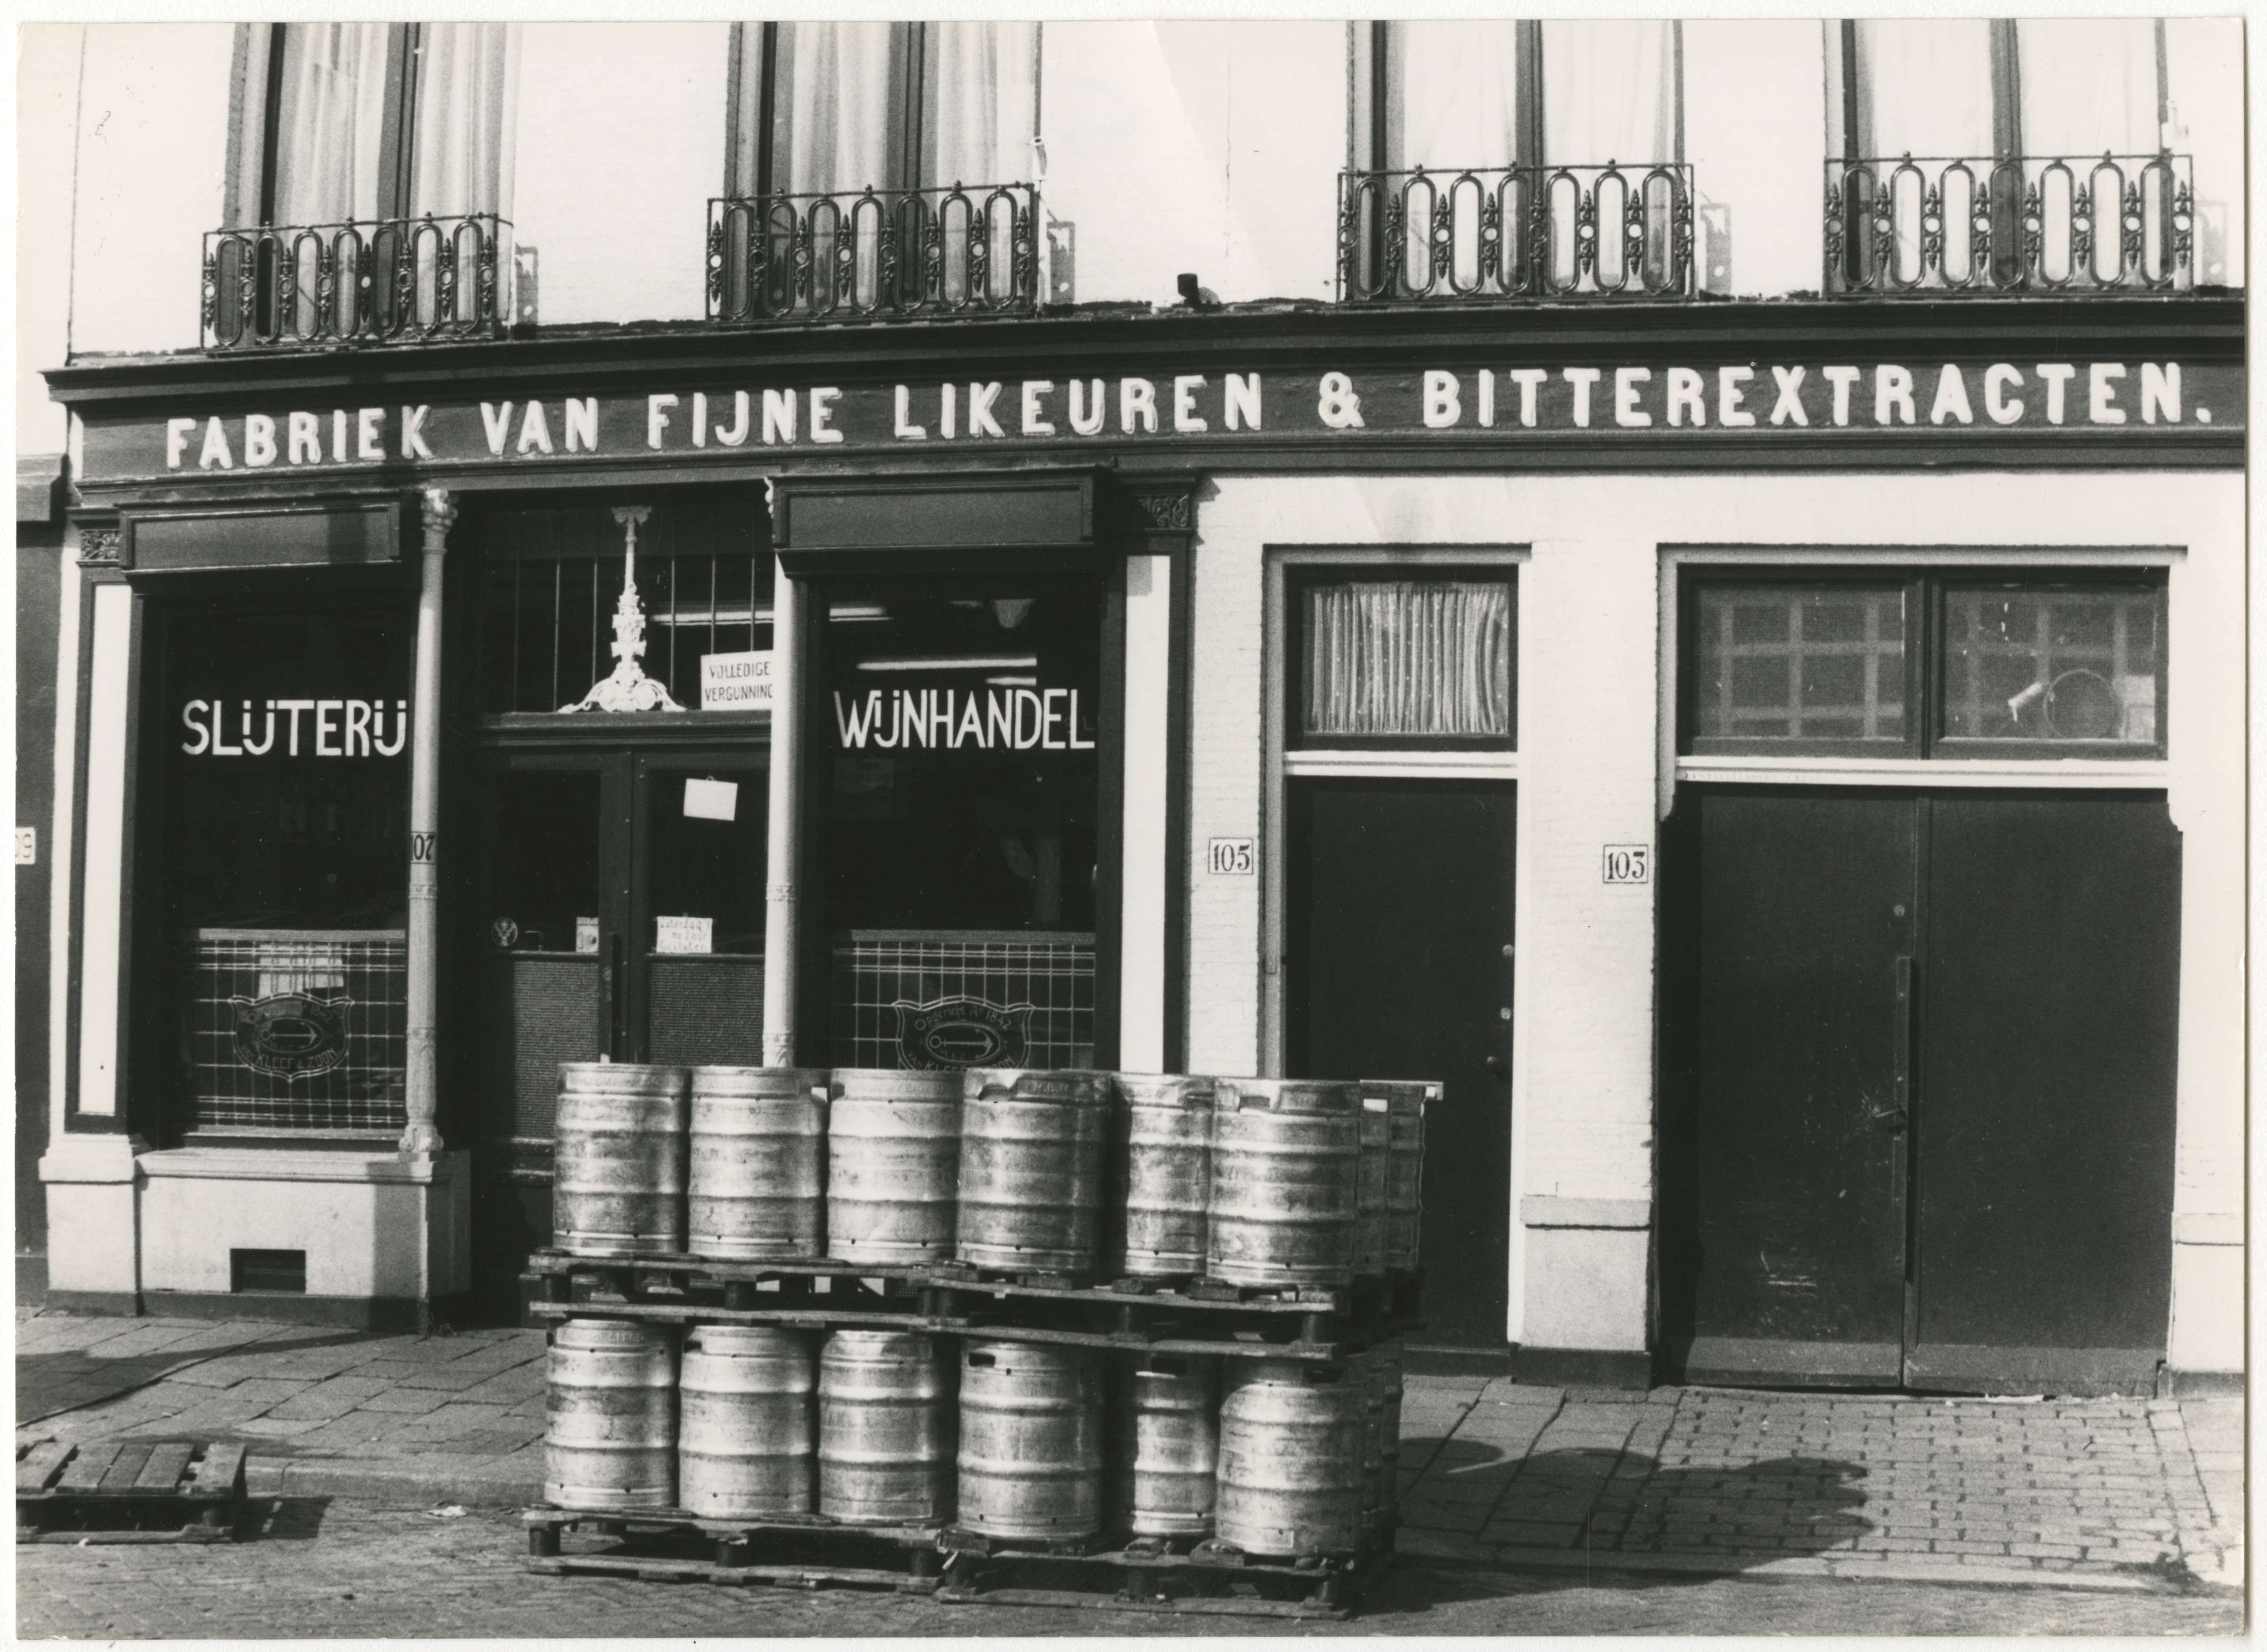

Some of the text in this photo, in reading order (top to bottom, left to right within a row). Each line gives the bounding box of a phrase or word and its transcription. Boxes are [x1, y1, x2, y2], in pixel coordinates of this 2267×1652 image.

[166, 362, 2212, 469] FABRIEK VAN FIJNE LIKEUREN & BITTEREXTRACTEN.
[709, 661, 771, 679] VOLLEDIGE
[1213, 844, 1251, 872] 105
[1607, 851, 1645, 880] 103
[985, 1010, 1012, 1031] 1842
[256, 1054, 295, 1070] KLEEF
